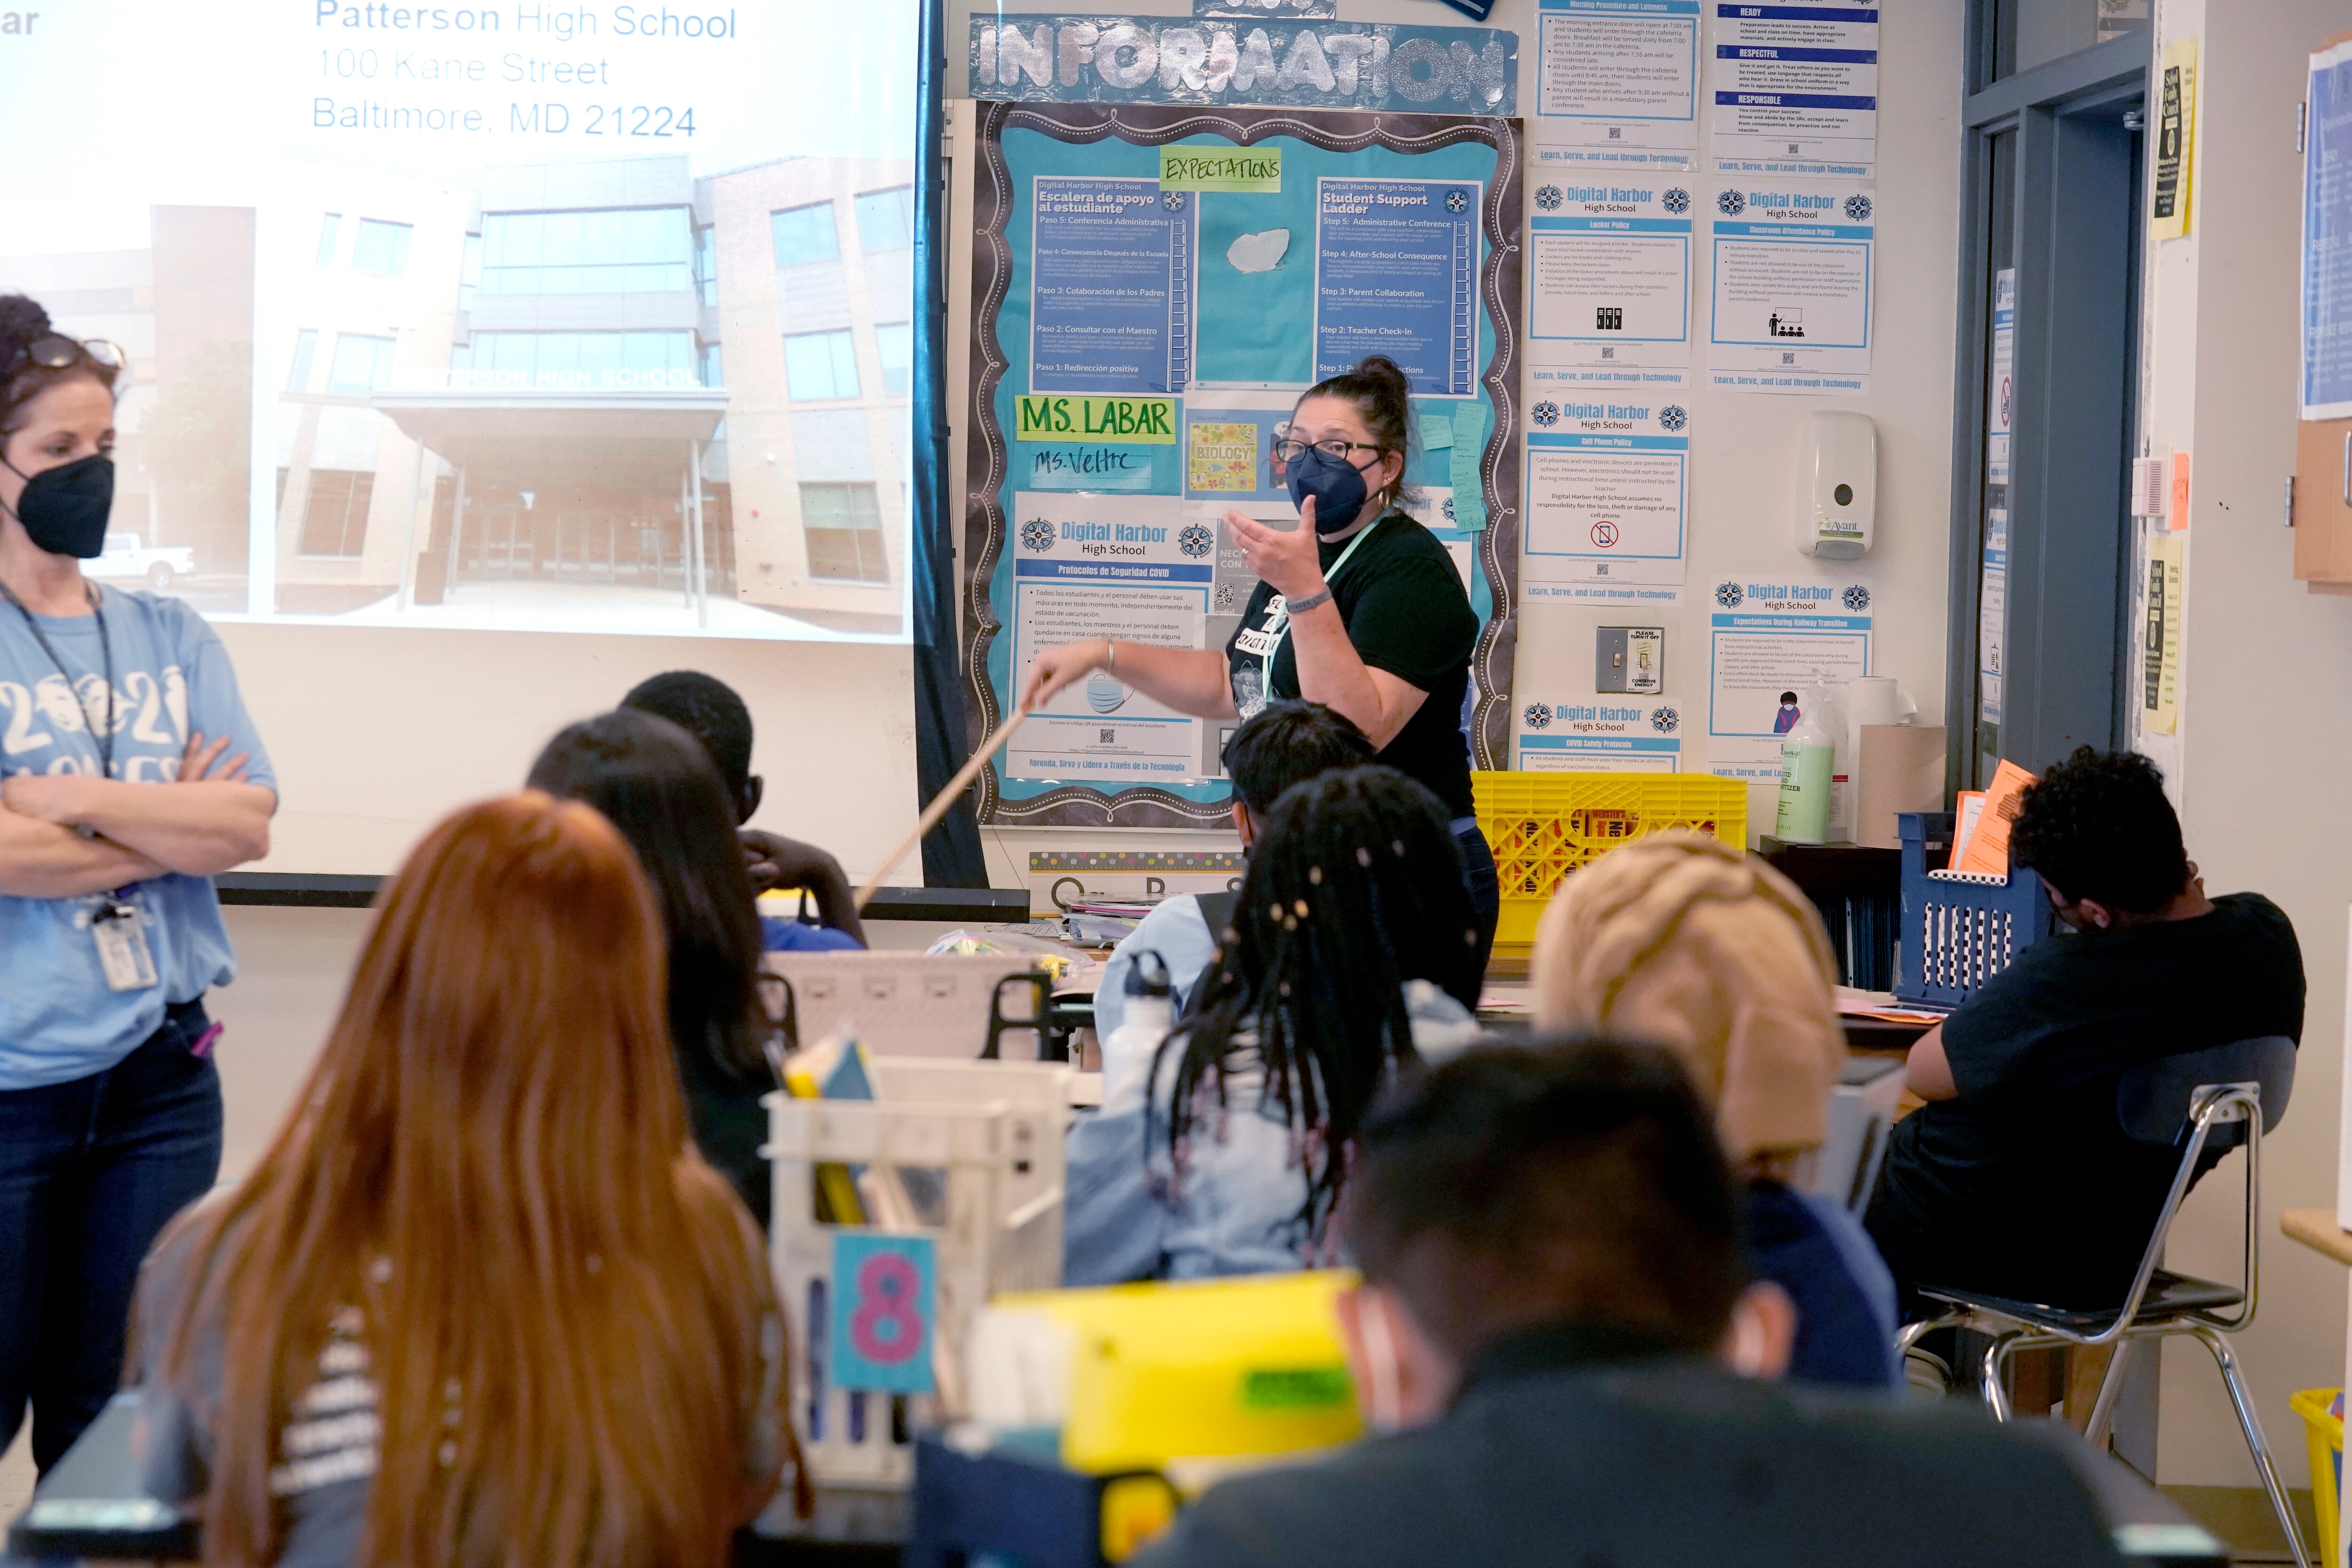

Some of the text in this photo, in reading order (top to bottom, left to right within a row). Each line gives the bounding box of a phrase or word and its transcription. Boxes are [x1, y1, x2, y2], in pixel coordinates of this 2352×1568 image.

[1569, 0, 1595, 9] Morning
[1740, 8, 1761, 16] READY
[316, 0, 736, 41] Patterson High School
[1739, 48, 1778, 58] RESPECTFUL
[318, 48, 609, 85] 100 Kane Street
[979, 23, 1505, 103] INFORMATION
[1738, 95, 1780, 104] RESPONSIBLE
[314, 97, 696, 137] Baltimore, MD 21224
[1165, 156, 1281, 181] EXPECTATIONS
[1038, 181, 1065, 190] Digital
[1095, 182, 1113, 191] High
[1322, 183, 1350, 191] Digital
[1349, 183, 1378, 191] Harbor
[1039, 191, 1154, 206] Escalera de apoyo
[1323, 192, 1427, 207] Student Support
[1567, 186, 1653, 202] Digital Harbor
[1749, 192, 1835, 208] Digital Harbor
[1038, 202, 1125, 213] al estudiante
[1322, 203, 1368, 214] Ladder
[1585, 203, 1604, 213] High
[1767, 210, 1786, 219] High
[1322, 217, 1340, 226] Step
[1109, 365, 1138, 374] positiva
[537, 368, 701, 386] HIGH SCHOOL
[1023, 398, 1171, 435] MS. LABAR
[1564, 403, 1650, 419] Digital Harbor
[1581, 420, 1600, 430] High
[1197, 446, 1250, 460] BIOLOGY
[1061, 521, 1168, 542] Digital Harbor
[1831, 521, 1858, 530] Avant
[1082, 543, 1145, 556] High School
[1058, 565, 1169, 577] Protocolos de Seguridad COVID
[1528, 587, 1549, 596] Learn,
[1551, 588, 1573, 596] Serve,
[1607, 589, 1635, 598] through
[1637, 590, 1676, 599] Technology
[1748, 584, 1833, 600] Digital Harbor
[1765, 601, 1784, 611] High
[1734, 617, 1772, 628] Expectations
[1793, 619, 1817, 627] Hallway
[1556, 705, 1642, 721] Digital Harbor
[1573, 723, 1592, 732] High
[1029, 759, 1057, 767] Aprenda,
[1082, 760, 1102, 768] Lidere
[1150, 763, 1185, 772] Tecnología
[850, 1250, 924, 1364] 8
